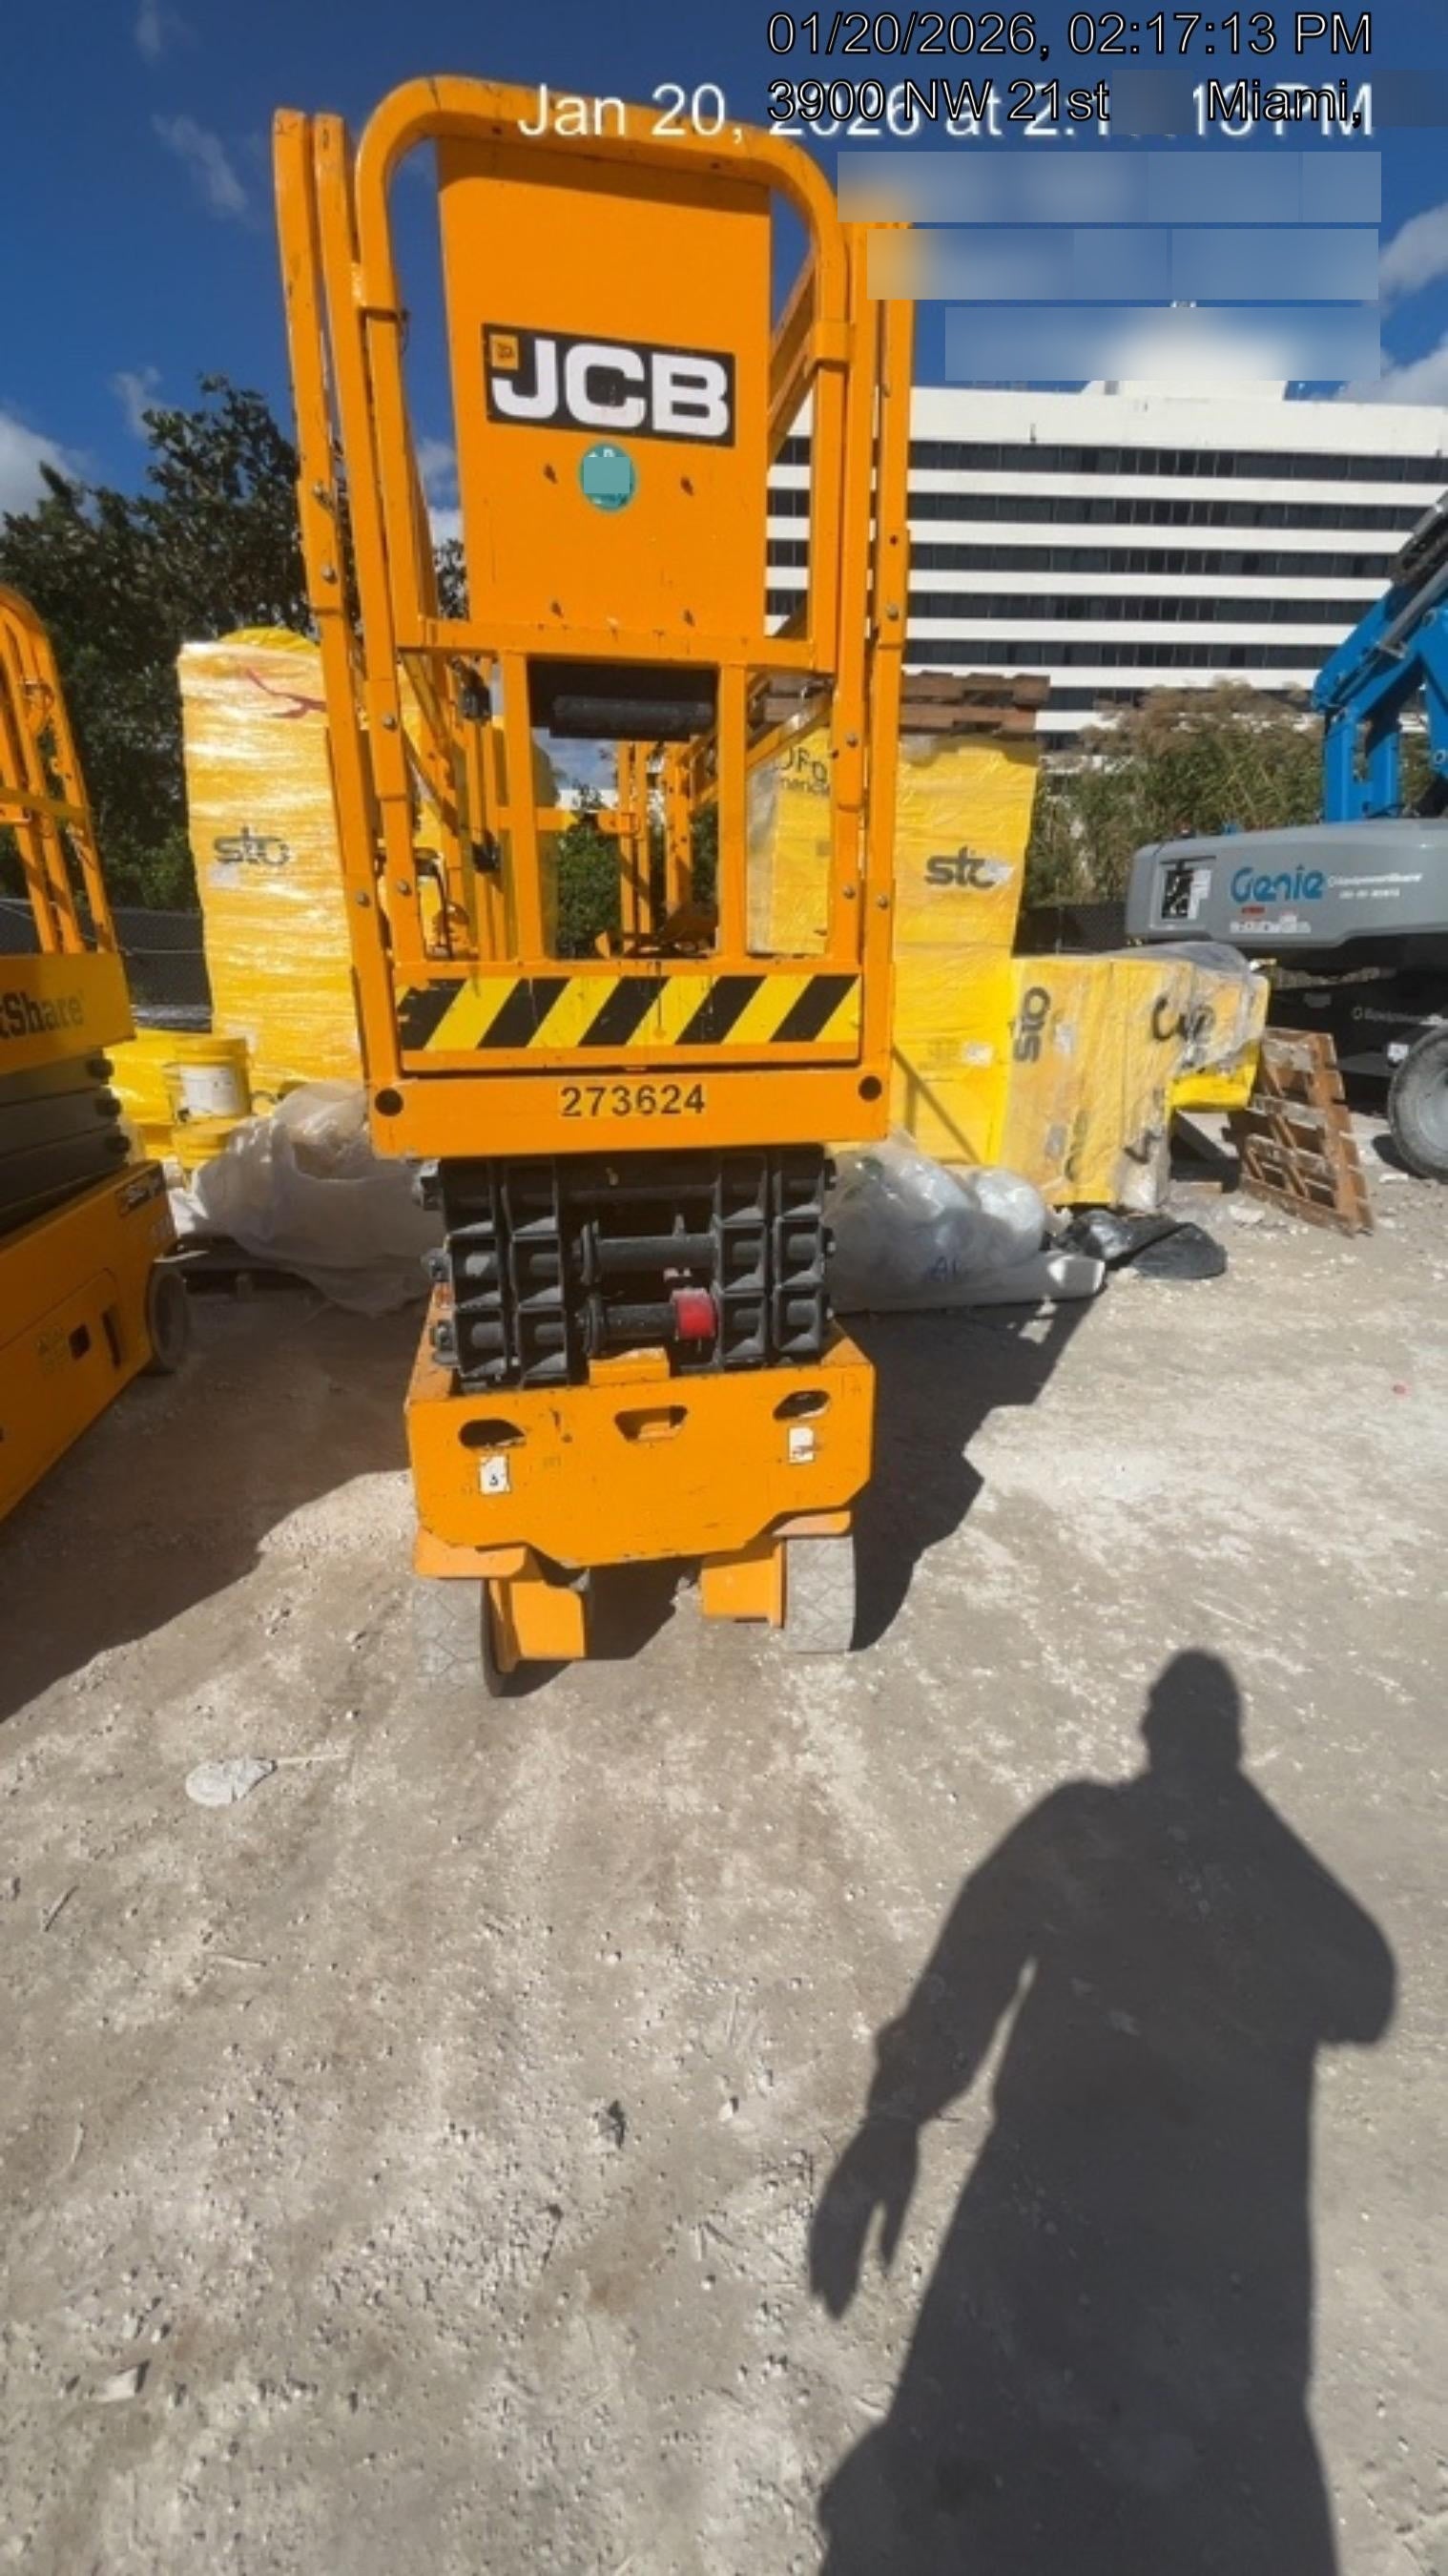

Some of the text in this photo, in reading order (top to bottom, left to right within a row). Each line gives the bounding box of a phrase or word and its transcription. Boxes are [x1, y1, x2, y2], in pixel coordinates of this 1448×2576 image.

[491, 339, 729, 437] JCB
[1231, 865, 1324, 903] Genie
[560, 1084, 706, 1116] 273624
